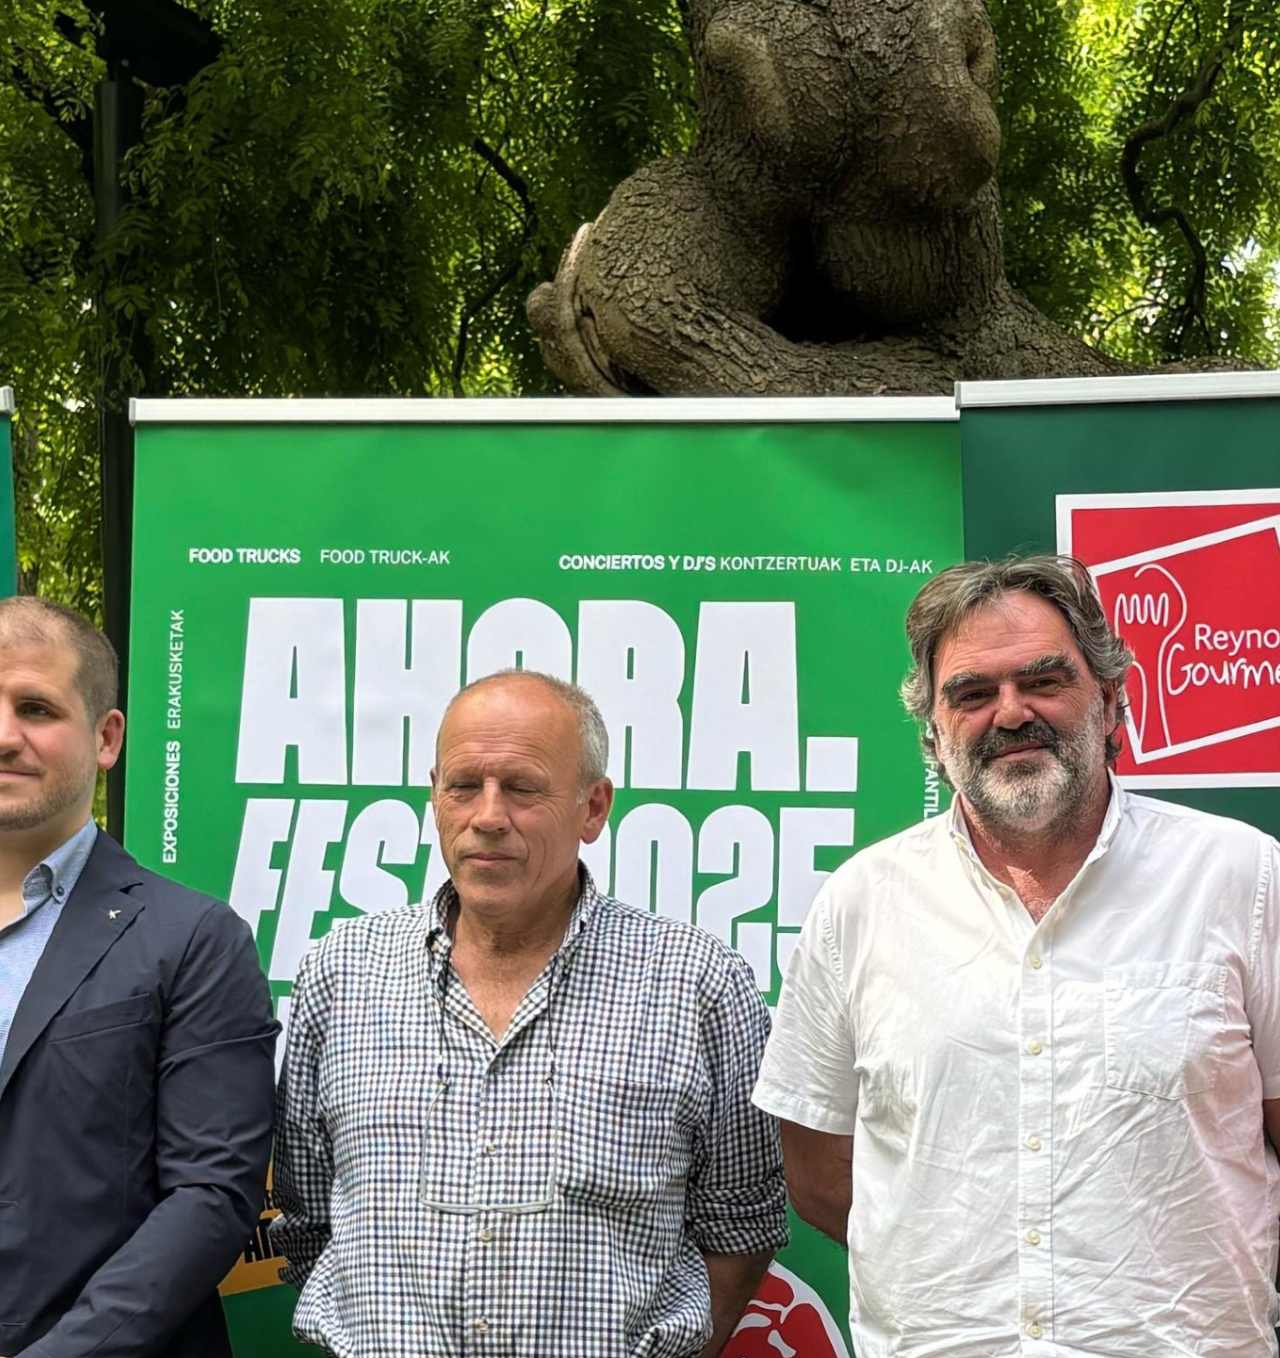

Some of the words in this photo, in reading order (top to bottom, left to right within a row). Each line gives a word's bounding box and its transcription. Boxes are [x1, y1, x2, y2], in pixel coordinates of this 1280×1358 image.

[189, 548, 233, 564] FOOD
[236, 548, 301, 564] TRUCKS
[320, 549, 364, 564] FOOD
[369, 549, 450, 565] TRUCK-AK
[559, 554, 665, 570] CONCIERTOS
[668, 555, 680, 570] Y
[683, 555, 717, 571] DJ'S
[720, 556, 841, 572] KONTZERTUAK
[850, 558, 881, 573] ETA
[886, 559, 933, 574] DJ-AK
[1195, 623, 1280, 656] Reyno
[167, 609, 184, 729] ERAKUSKETAK
[163, 741, 181, 864] EXPOSICIONES
[227, 798, 438, 981] FES
[594, 803, 854, 991] 025
